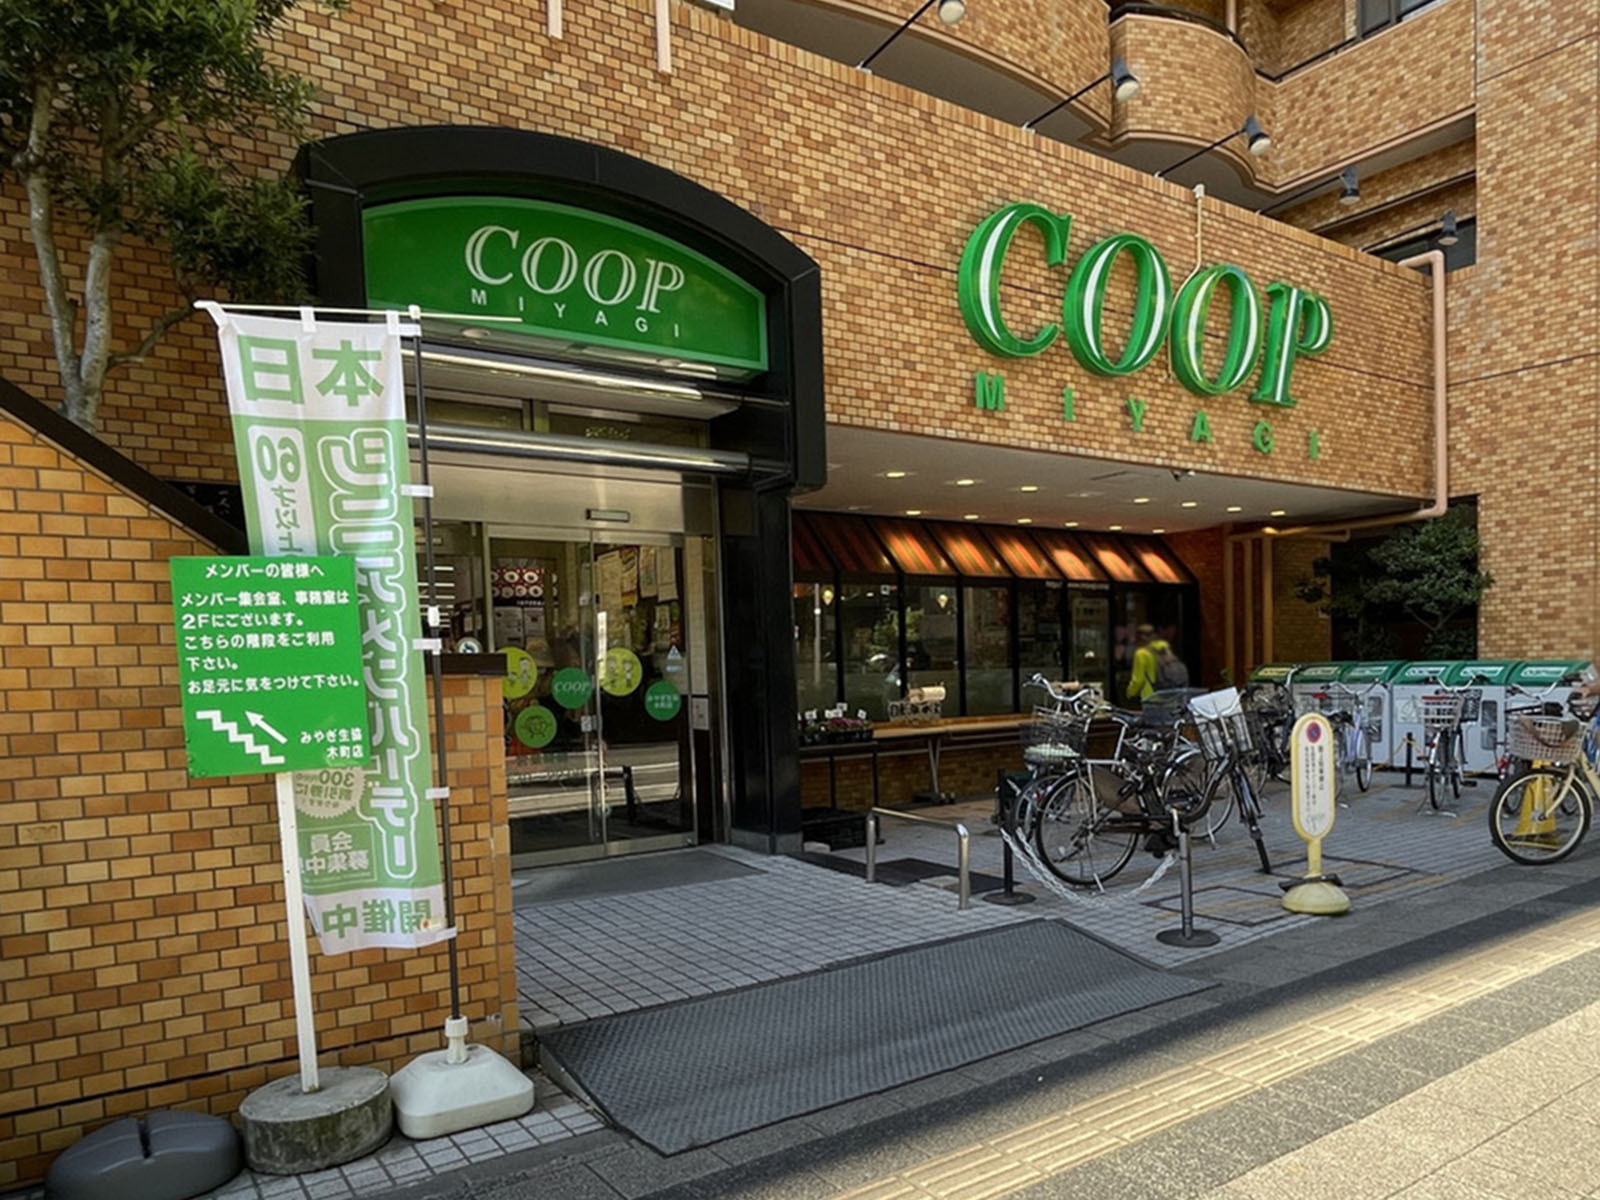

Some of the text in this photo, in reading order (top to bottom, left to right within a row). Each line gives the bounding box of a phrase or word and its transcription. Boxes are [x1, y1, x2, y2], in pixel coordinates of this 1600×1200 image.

[465, 225, 684, 313] COOP
[471, 288, 679, 337] MIYAGI
[957, 201, 1333, 407] COOP
[974, 371, 1319, 460] MIYAGI
[204, 563, 325, 579] メンバーの皆様へ
[182, 612, 304, 630] 2Fにございます。
[184, 631, 335, 650] こちらの階段をご利用
[186, 656, 239, 672] 下さい。
[188, 674, 359, 694] お足元に気をつけて下さい。
[300, 728, 362, 744] みやぎ生協
